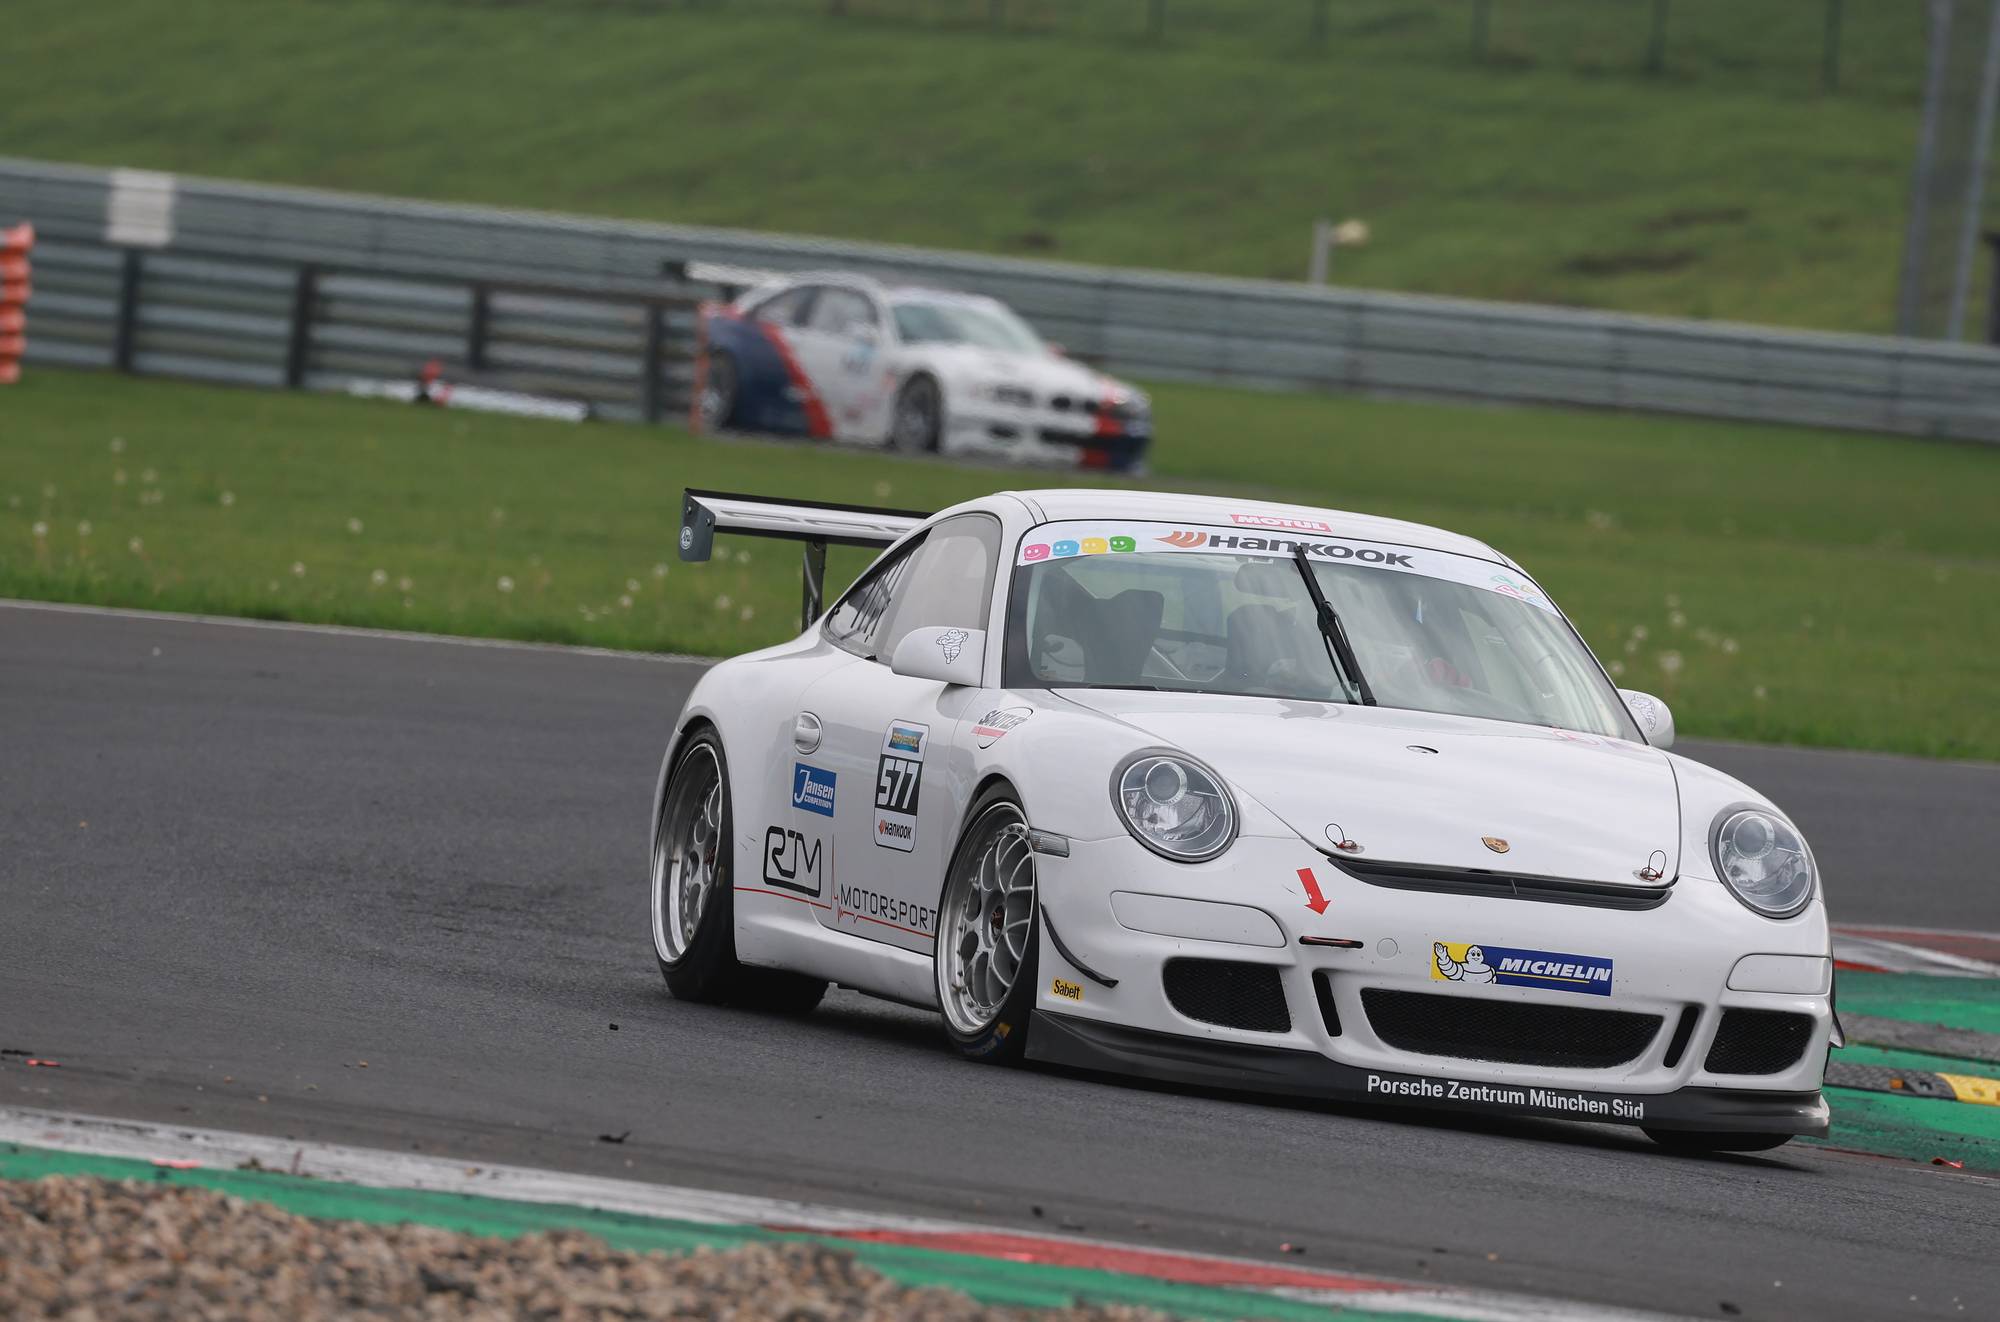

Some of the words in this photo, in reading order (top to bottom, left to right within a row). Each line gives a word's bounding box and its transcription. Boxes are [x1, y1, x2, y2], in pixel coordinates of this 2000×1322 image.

[1238, 516, 1326, 530] MOTUL
[794, 769, 834, 803] Jansen
[877, 757, 920, 809] 577
[840, 883, 937, 932] MOTORSPORT
[1499, 957, 1612, 982] MICHELIN
[1053, 979, 1081, 1000] Sabelt
[1367, 1075, 1444, 1098] Porsche
[1447, 1081, 1525, 1105] Zentrum
[1529, 1088, 1609, 1115] München
[1612, 1098, 1645, 1120] Süd
